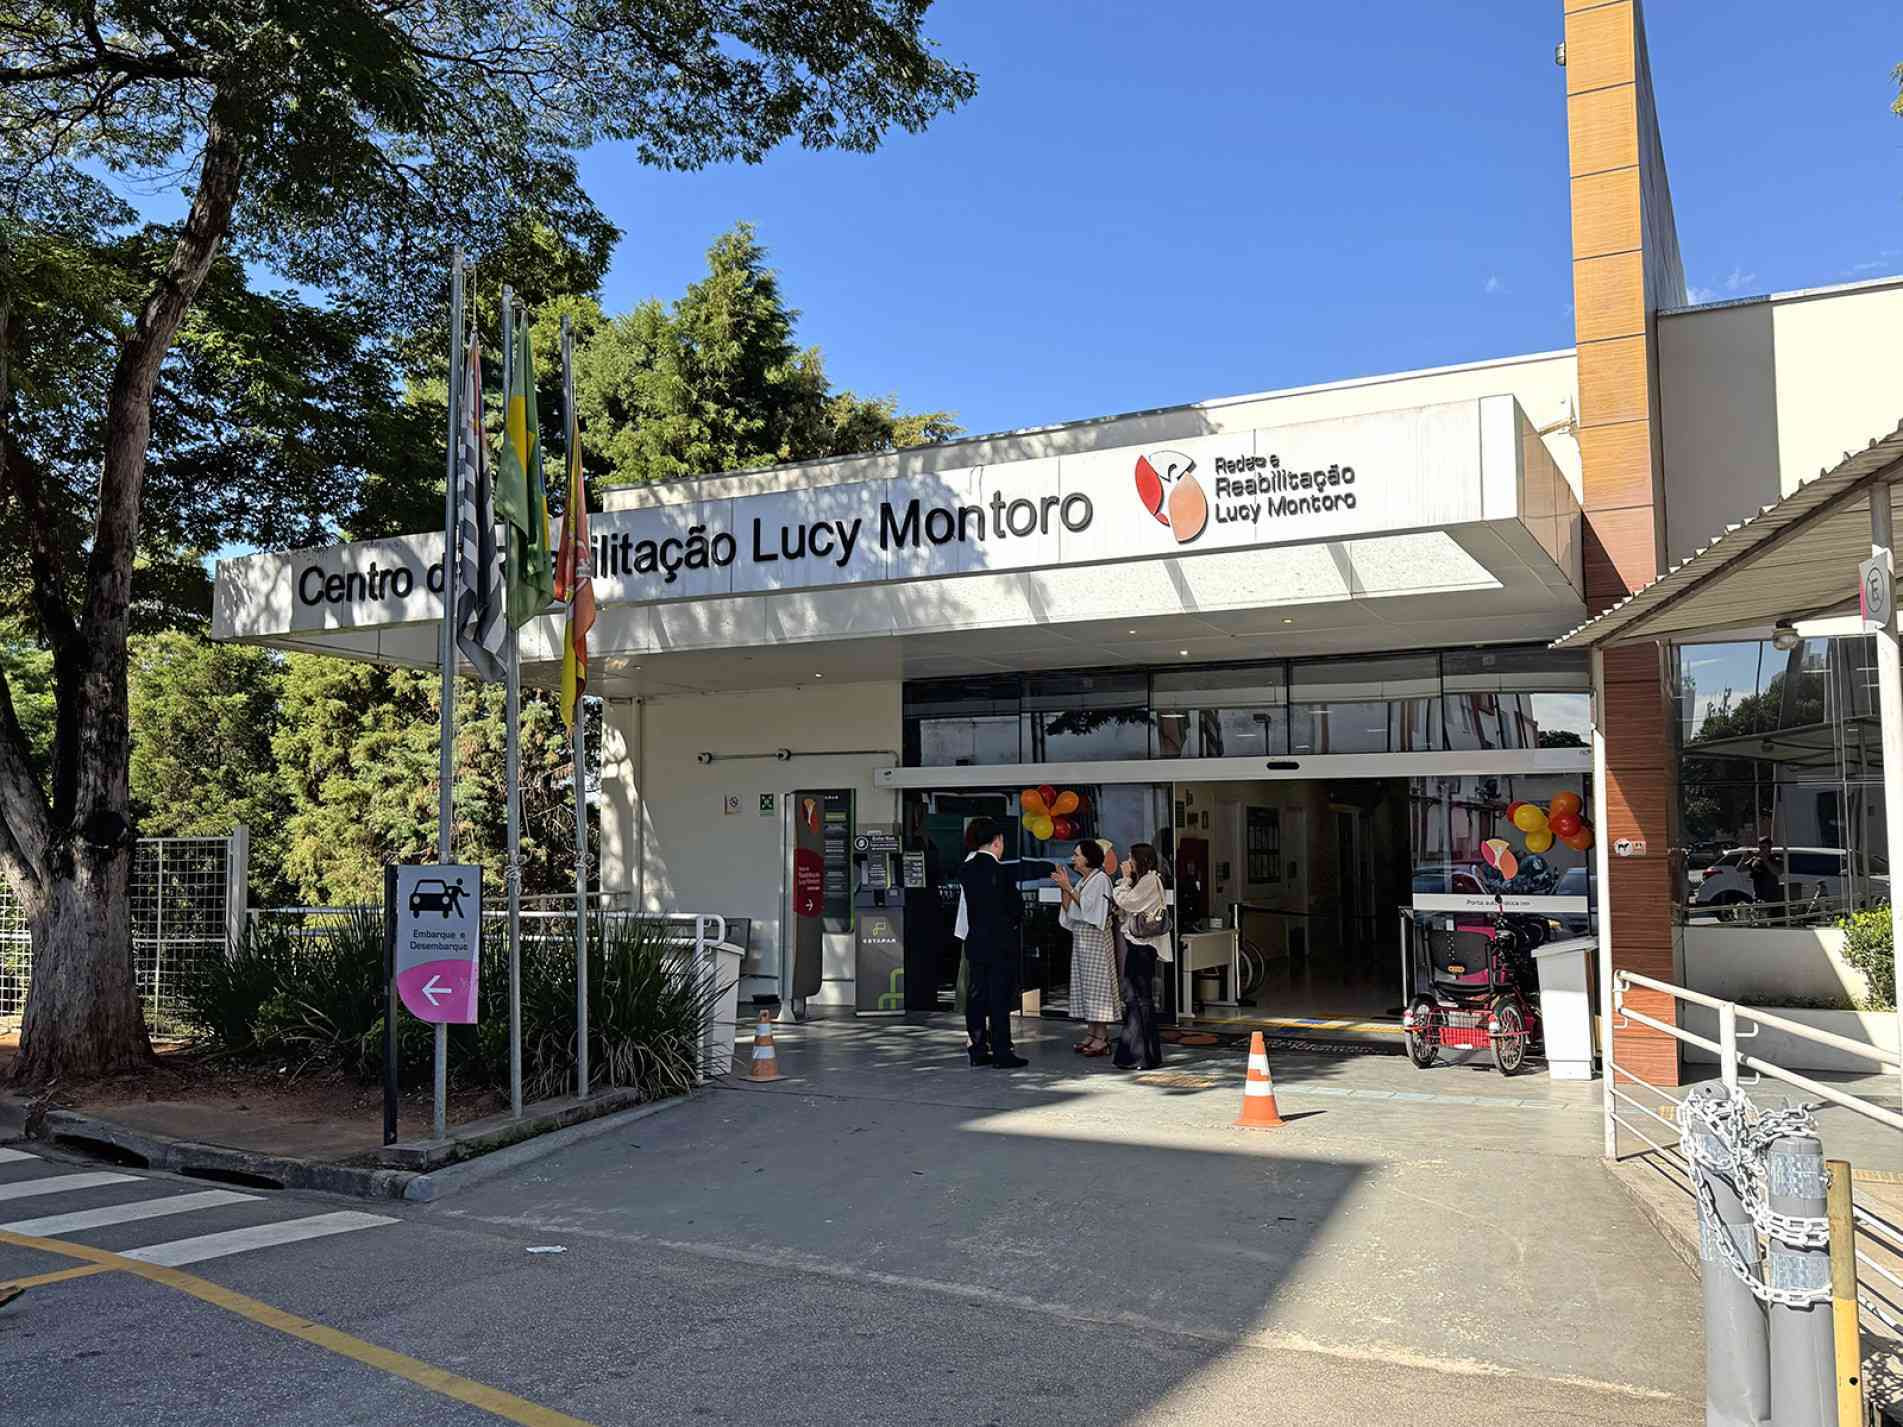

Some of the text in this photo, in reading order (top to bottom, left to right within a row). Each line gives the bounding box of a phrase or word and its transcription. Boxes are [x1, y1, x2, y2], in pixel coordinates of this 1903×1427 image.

[1215, 464, 1356, 499] Reabilitação
[1215, 491, 1357, 525] Lucy Montoro
[299, 561, 414, 606] Centro
[752, 516, 862, 568] Lucy
[879, 491, 1094, 549] Montoro
[410, 941, 469, 952] Desembarque
[413, 929, 455, 940] Embarque
